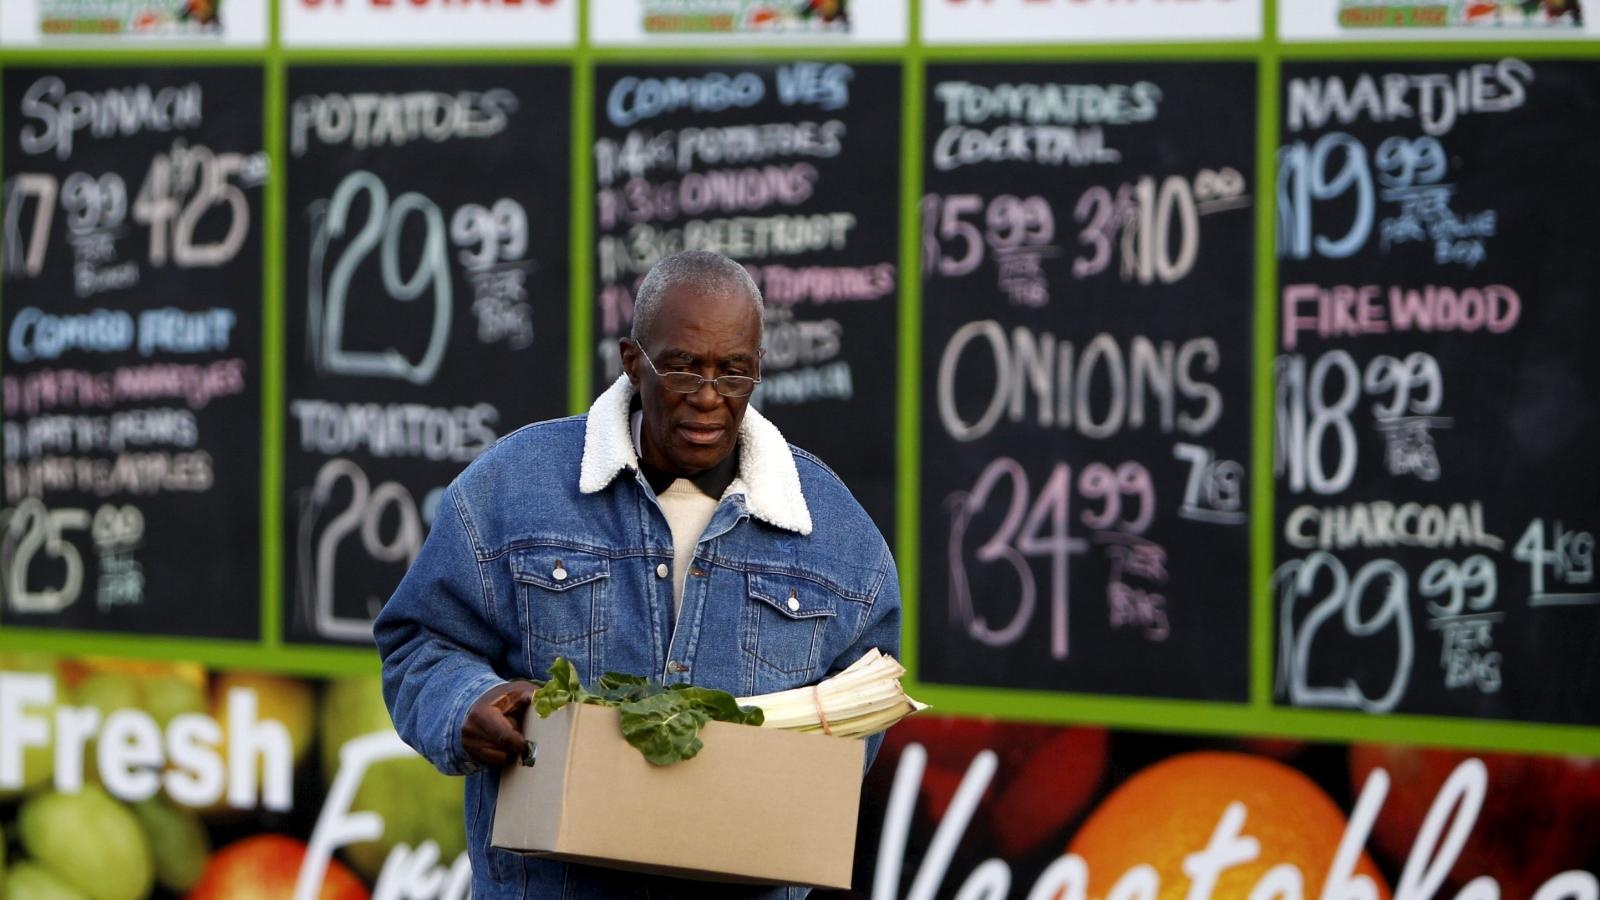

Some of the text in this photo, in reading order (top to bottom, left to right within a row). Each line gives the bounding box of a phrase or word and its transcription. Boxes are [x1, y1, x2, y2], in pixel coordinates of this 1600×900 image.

[291, 89, 518, 157] POTATOES
[606, 73, 766, 127] COMBO
[934, 81, 1163, 126] TOMATOES
[1287, 57, 1534, 136] NAARTJIES
[677, 119, 847, 174] POTATOES
[932, 123, 1122, 171] COCKTAIL
[679, 162, 820, 216] ONIONS
[937, 319, 1223, 441] ONIONS
[291, 399, 498, 462] TOMATOES
[1285, 500, 1504, 551] CHARCOAL
[0, 671, 294, 812] Fresh
